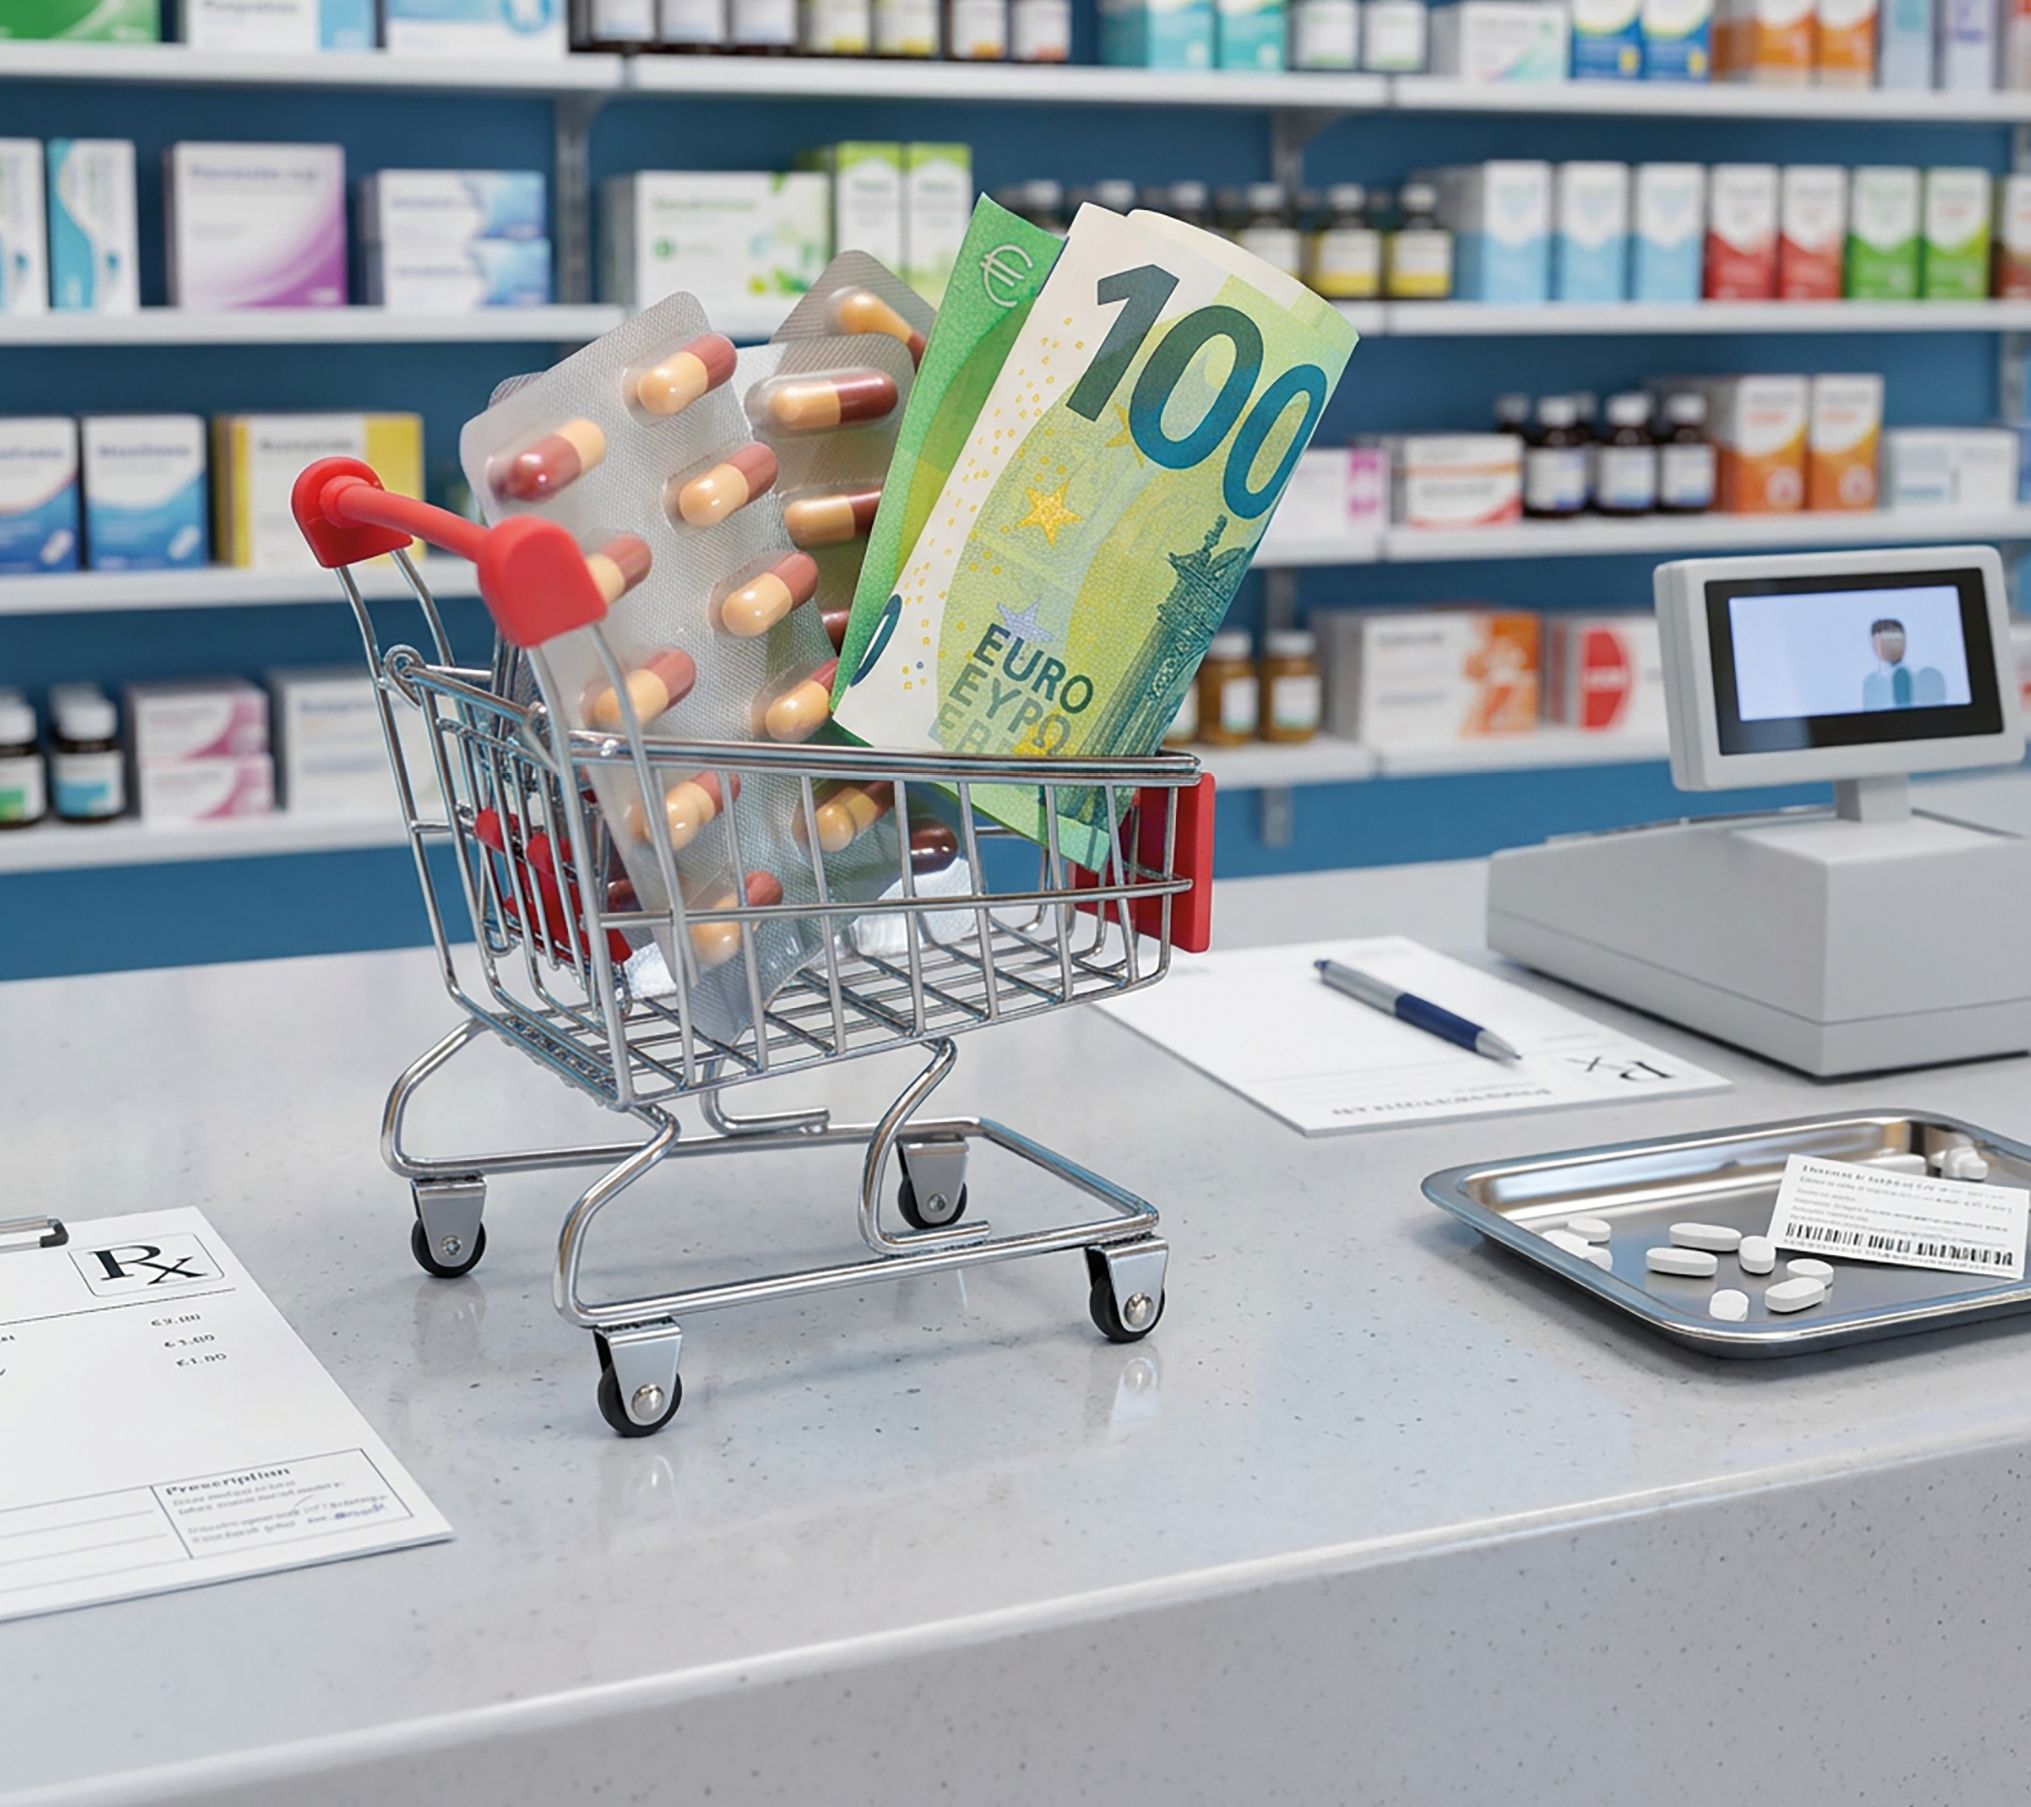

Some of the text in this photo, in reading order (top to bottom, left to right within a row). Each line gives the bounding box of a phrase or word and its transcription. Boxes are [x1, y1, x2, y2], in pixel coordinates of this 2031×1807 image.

[979, 244, 1033, 309] €
[1065, 263, 1328, 520] 100
[973, 622, 1094, 714] EURO
[88, 1245, 208, 1285] Rx
